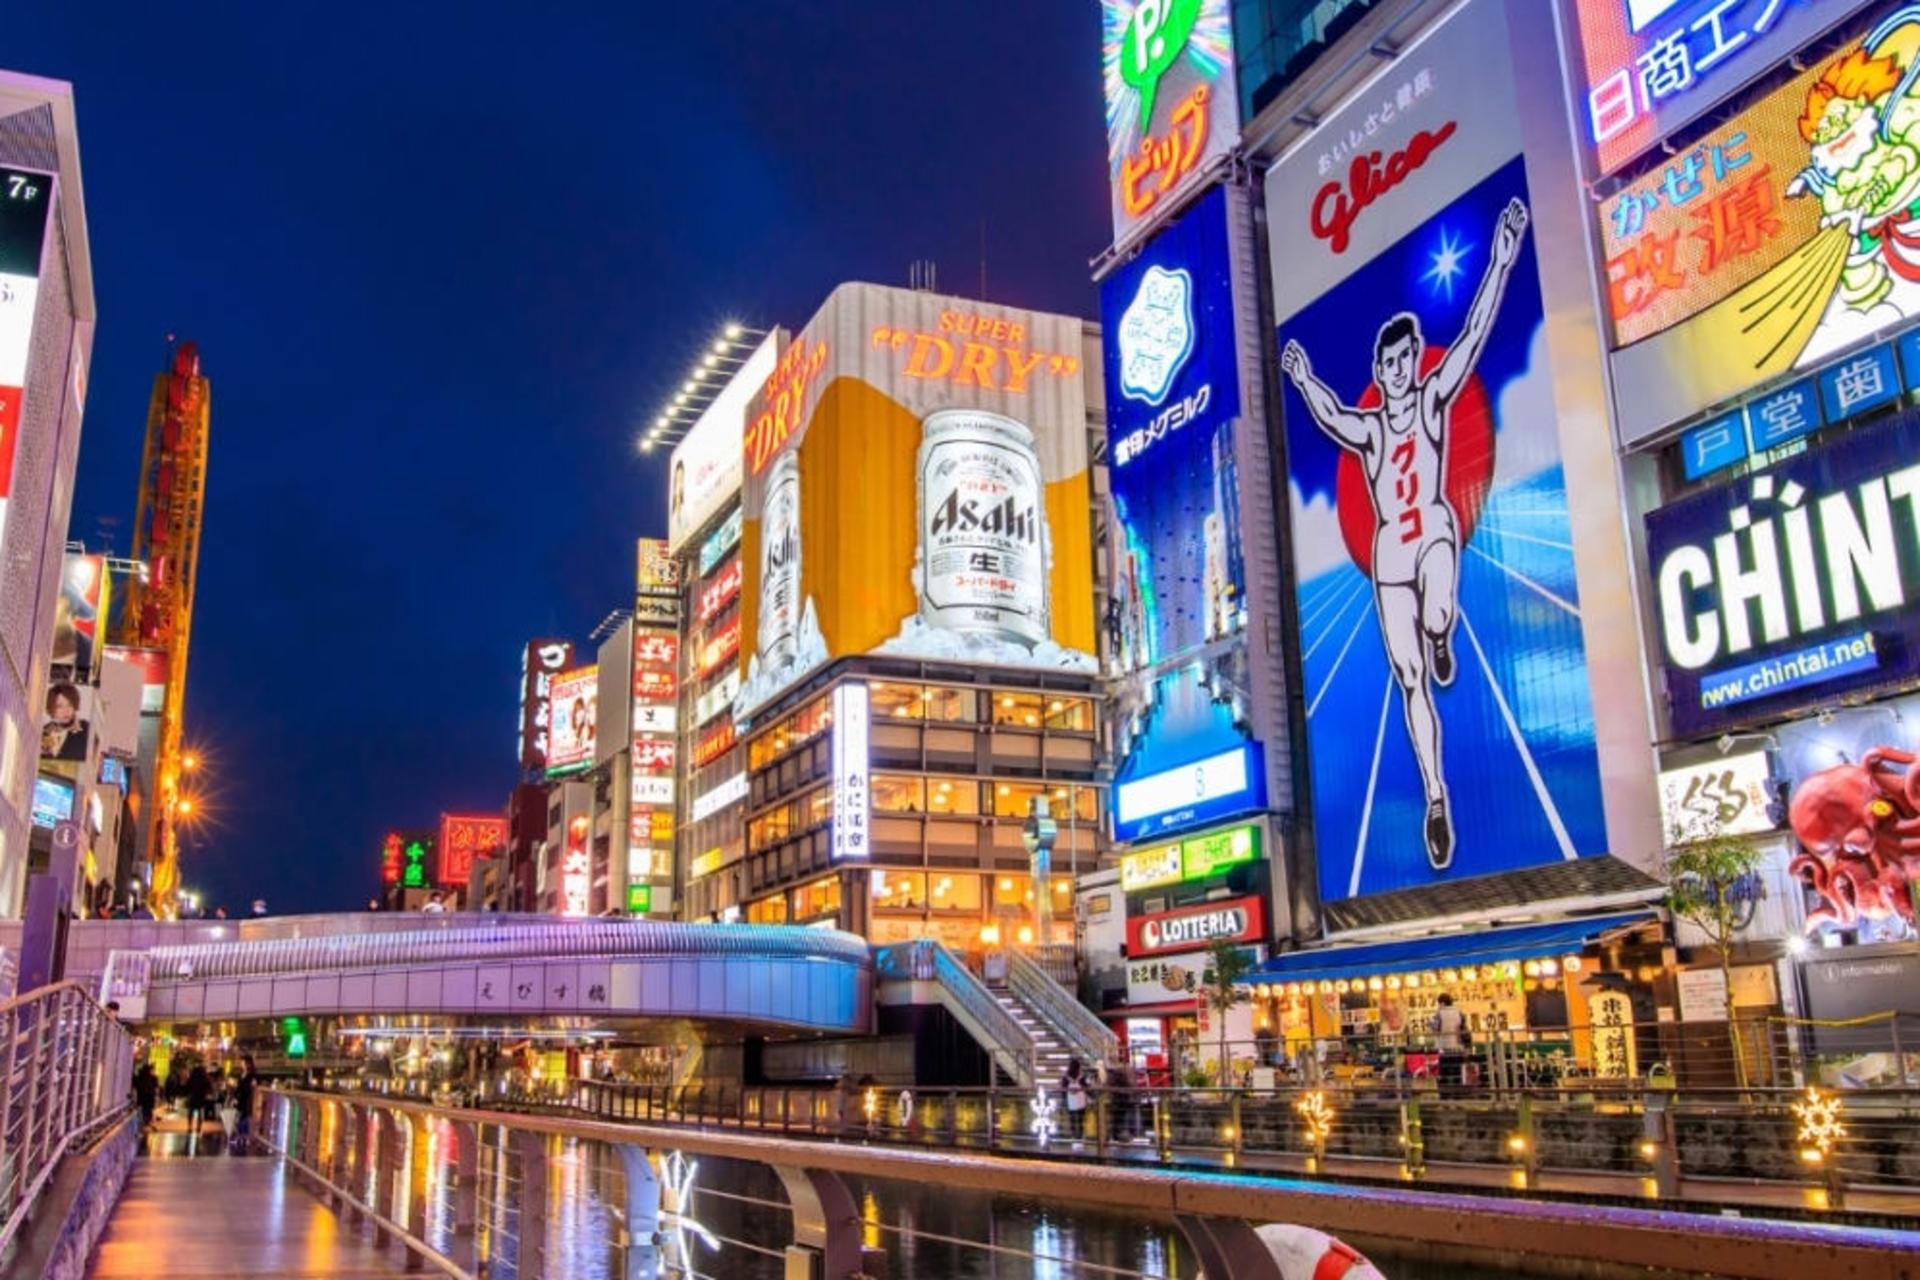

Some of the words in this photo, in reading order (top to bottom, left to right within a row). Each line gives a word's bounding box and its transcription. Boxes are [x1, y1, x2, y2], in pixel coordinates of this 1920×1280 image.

[1589, 0, 1780, 141] 日商エ
[1121, 83, 1210, 216] ピップ
[1611, 131, 1754, 239] かぜに
[1606, 164, 1784, 319] 改源
[939, 308, 1026, 342] SUPER
[931, 487, 1035, 546] Asahi
[1391, 432, 1423, 545] グリコ
[970, 552, 1000, 574] 生
[1162, 907, 1238, 943] LOTTERIA
[480, 981, 607, 1004] えびす橋
